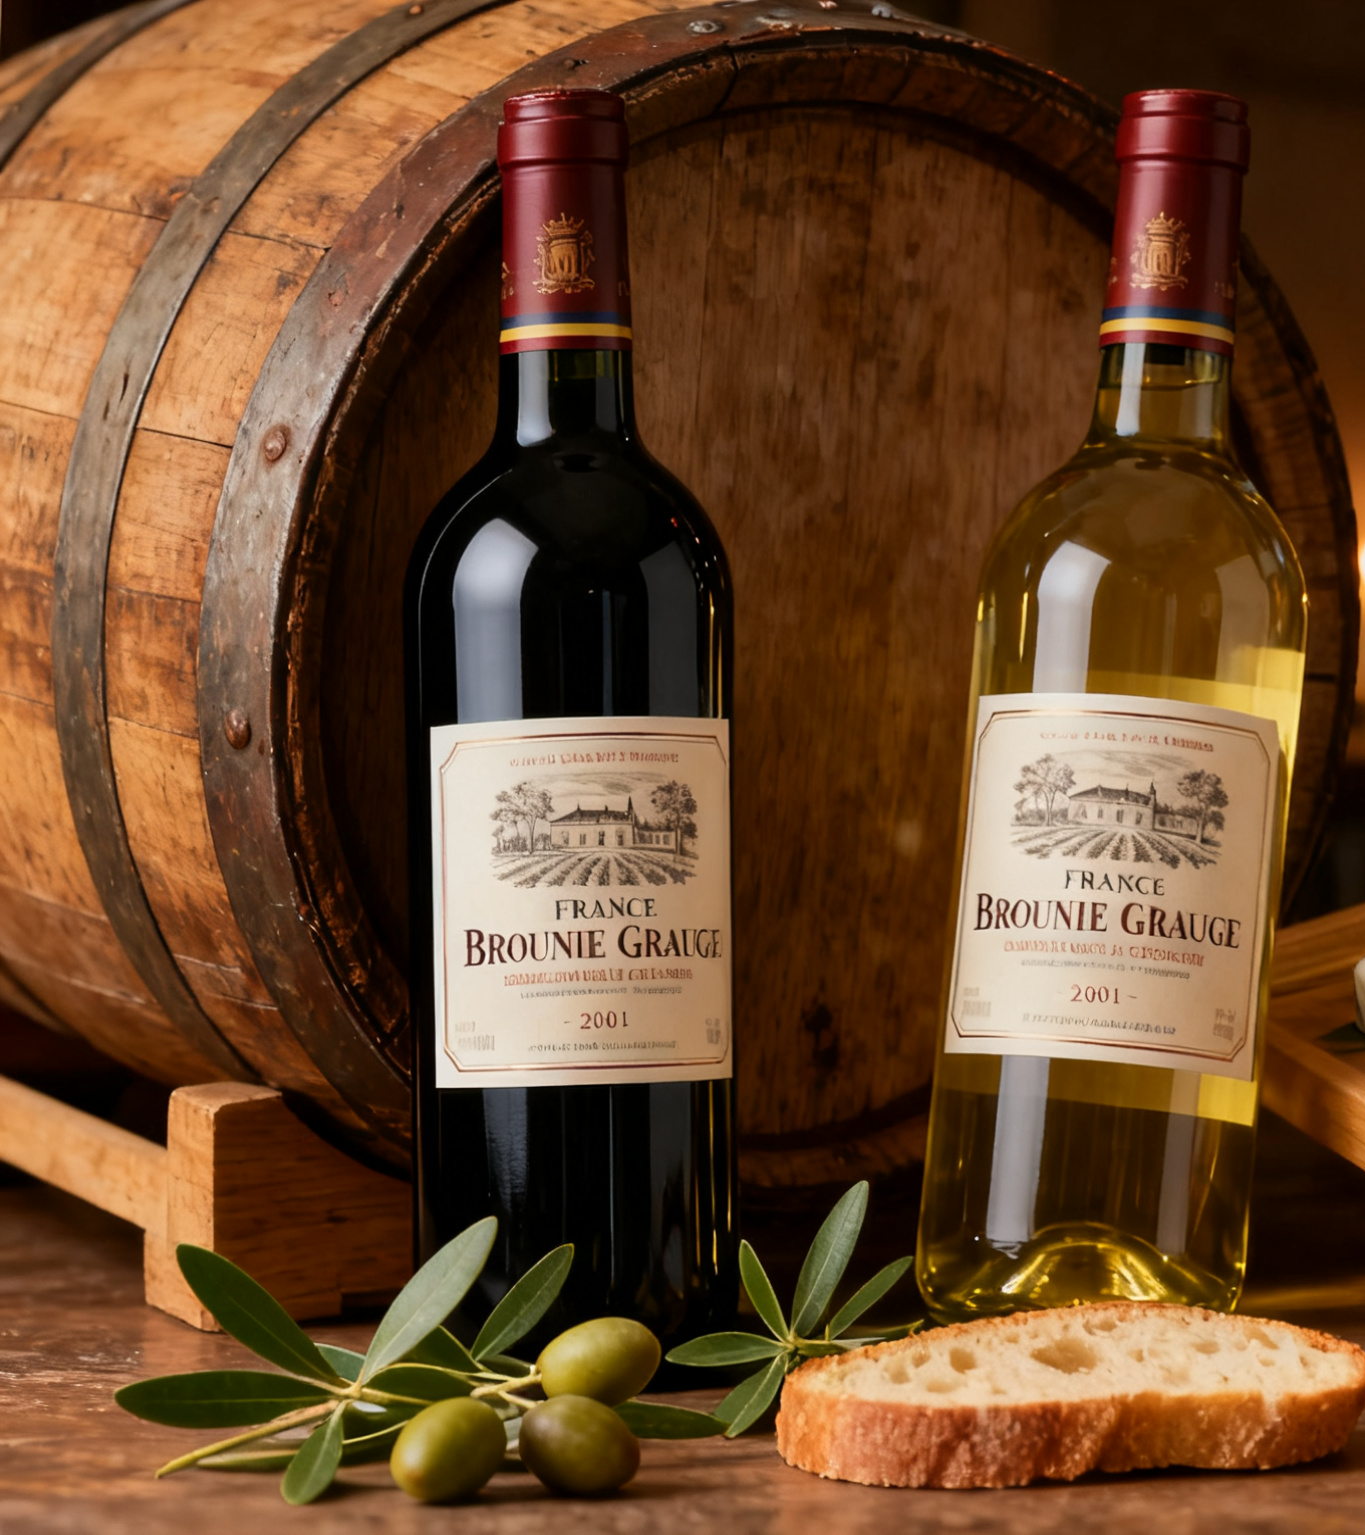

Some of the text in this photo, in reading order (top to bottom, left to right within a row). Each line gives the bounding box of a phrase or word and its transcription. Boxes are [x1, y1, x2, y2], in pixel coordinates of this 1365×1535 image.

[1064, 870, 1165, 896] FRANCE
[555, 898, 657, 920] FRANCE
[975, 893, 1242, 949] BROUNIE GRAUGE
[464, 929, 606, 967] BROUNIE
[1070, 984, 1120, 1005] 2001
[580, 1011, 629, 1030] 2001
